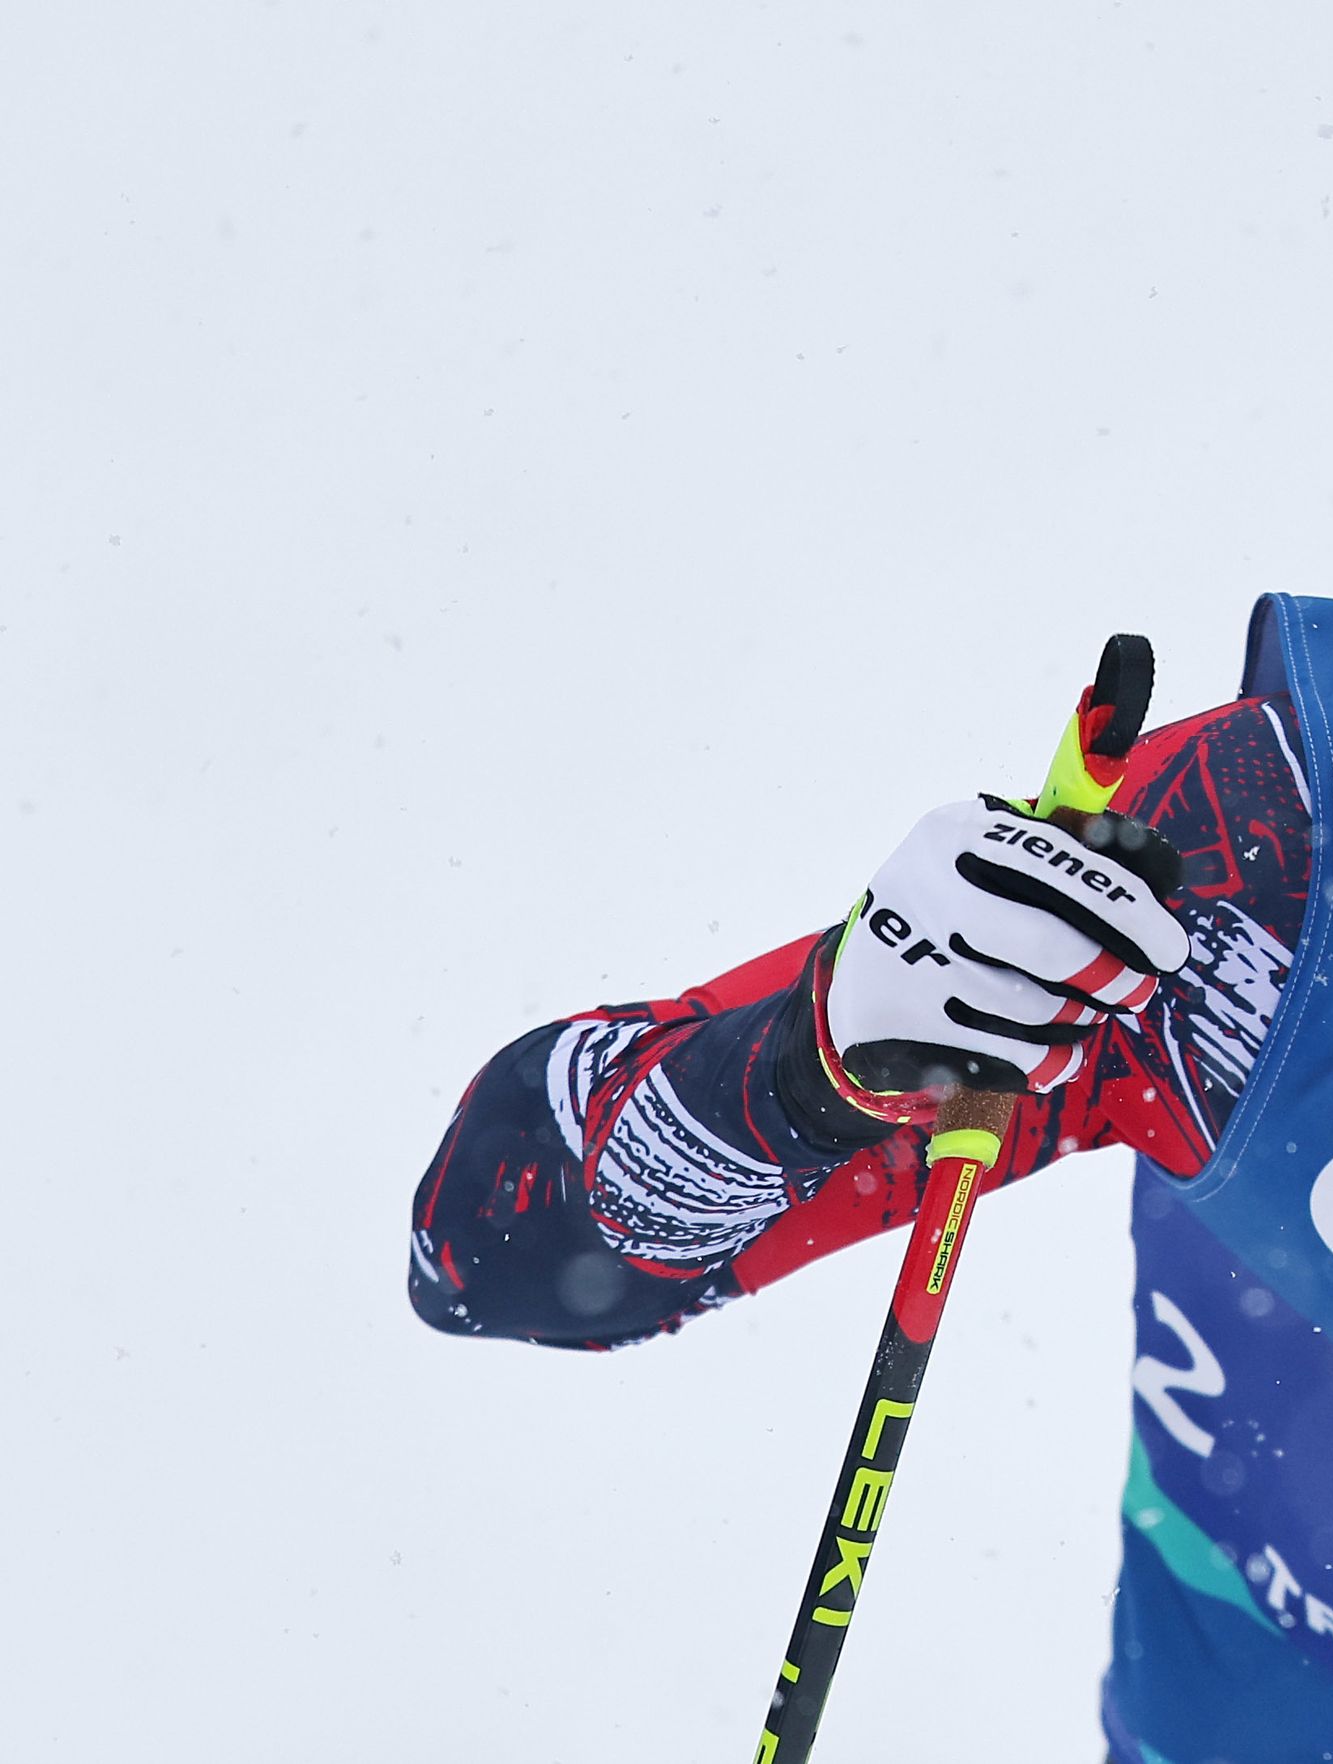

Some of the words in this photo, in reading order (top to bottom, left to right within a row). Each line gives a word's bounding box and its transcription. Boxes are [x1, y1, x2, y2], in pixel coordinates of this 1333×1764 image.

[949, 1167, 973, 1230] NORDIC
[930, 1231, 955, 1290] SHARK
[812, 1398, 916, 1628] LEKI
